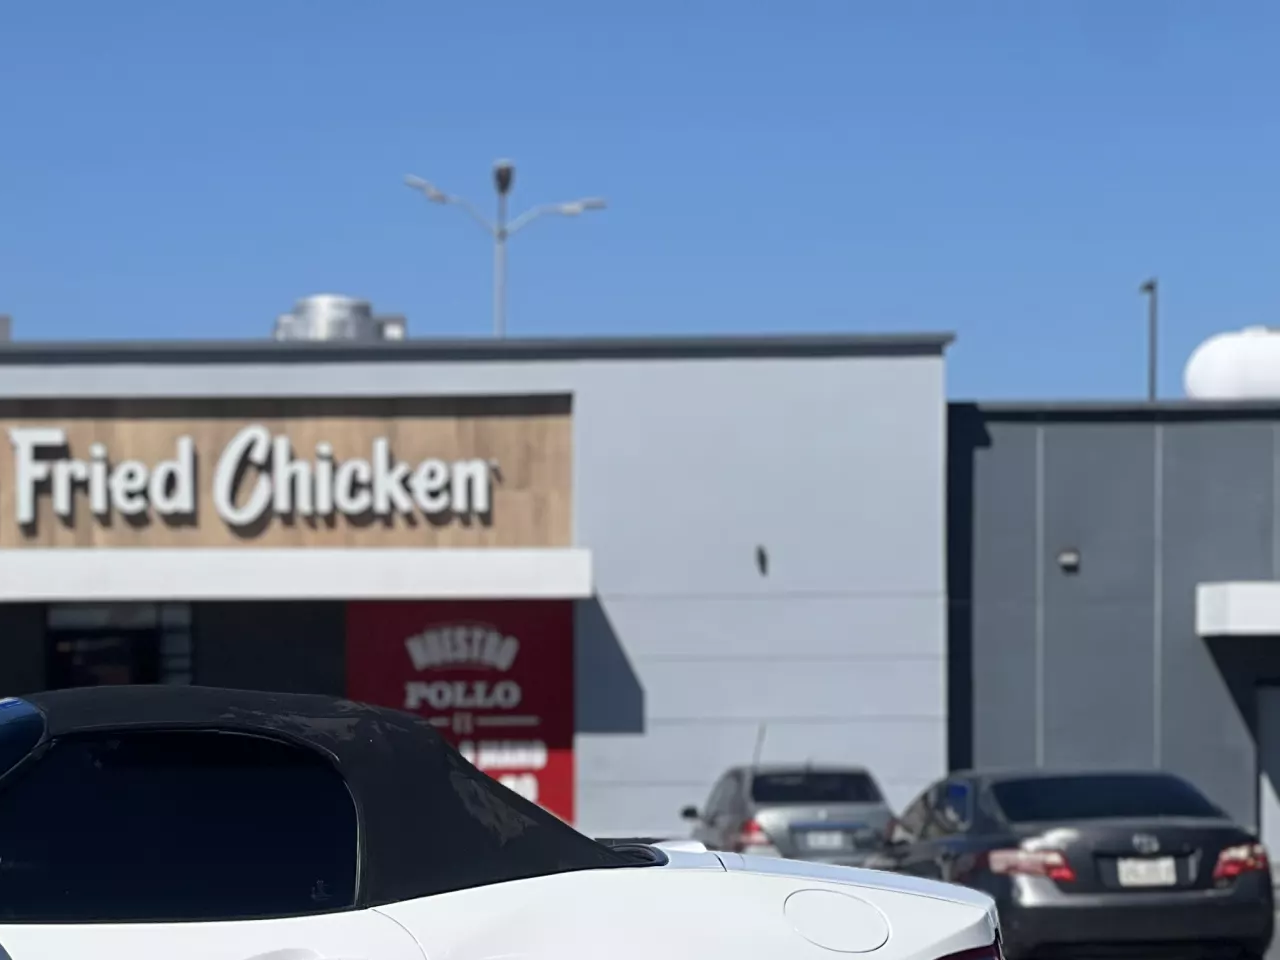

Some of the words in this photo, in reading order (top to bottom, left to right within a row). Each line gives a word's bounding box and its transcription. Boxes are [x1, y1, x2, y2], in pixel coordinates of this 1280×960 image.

[8, 427, 196, 525] Fried
[212, 423, 490, 525] Chicken
[404, 680, 522, 710] POLLO
